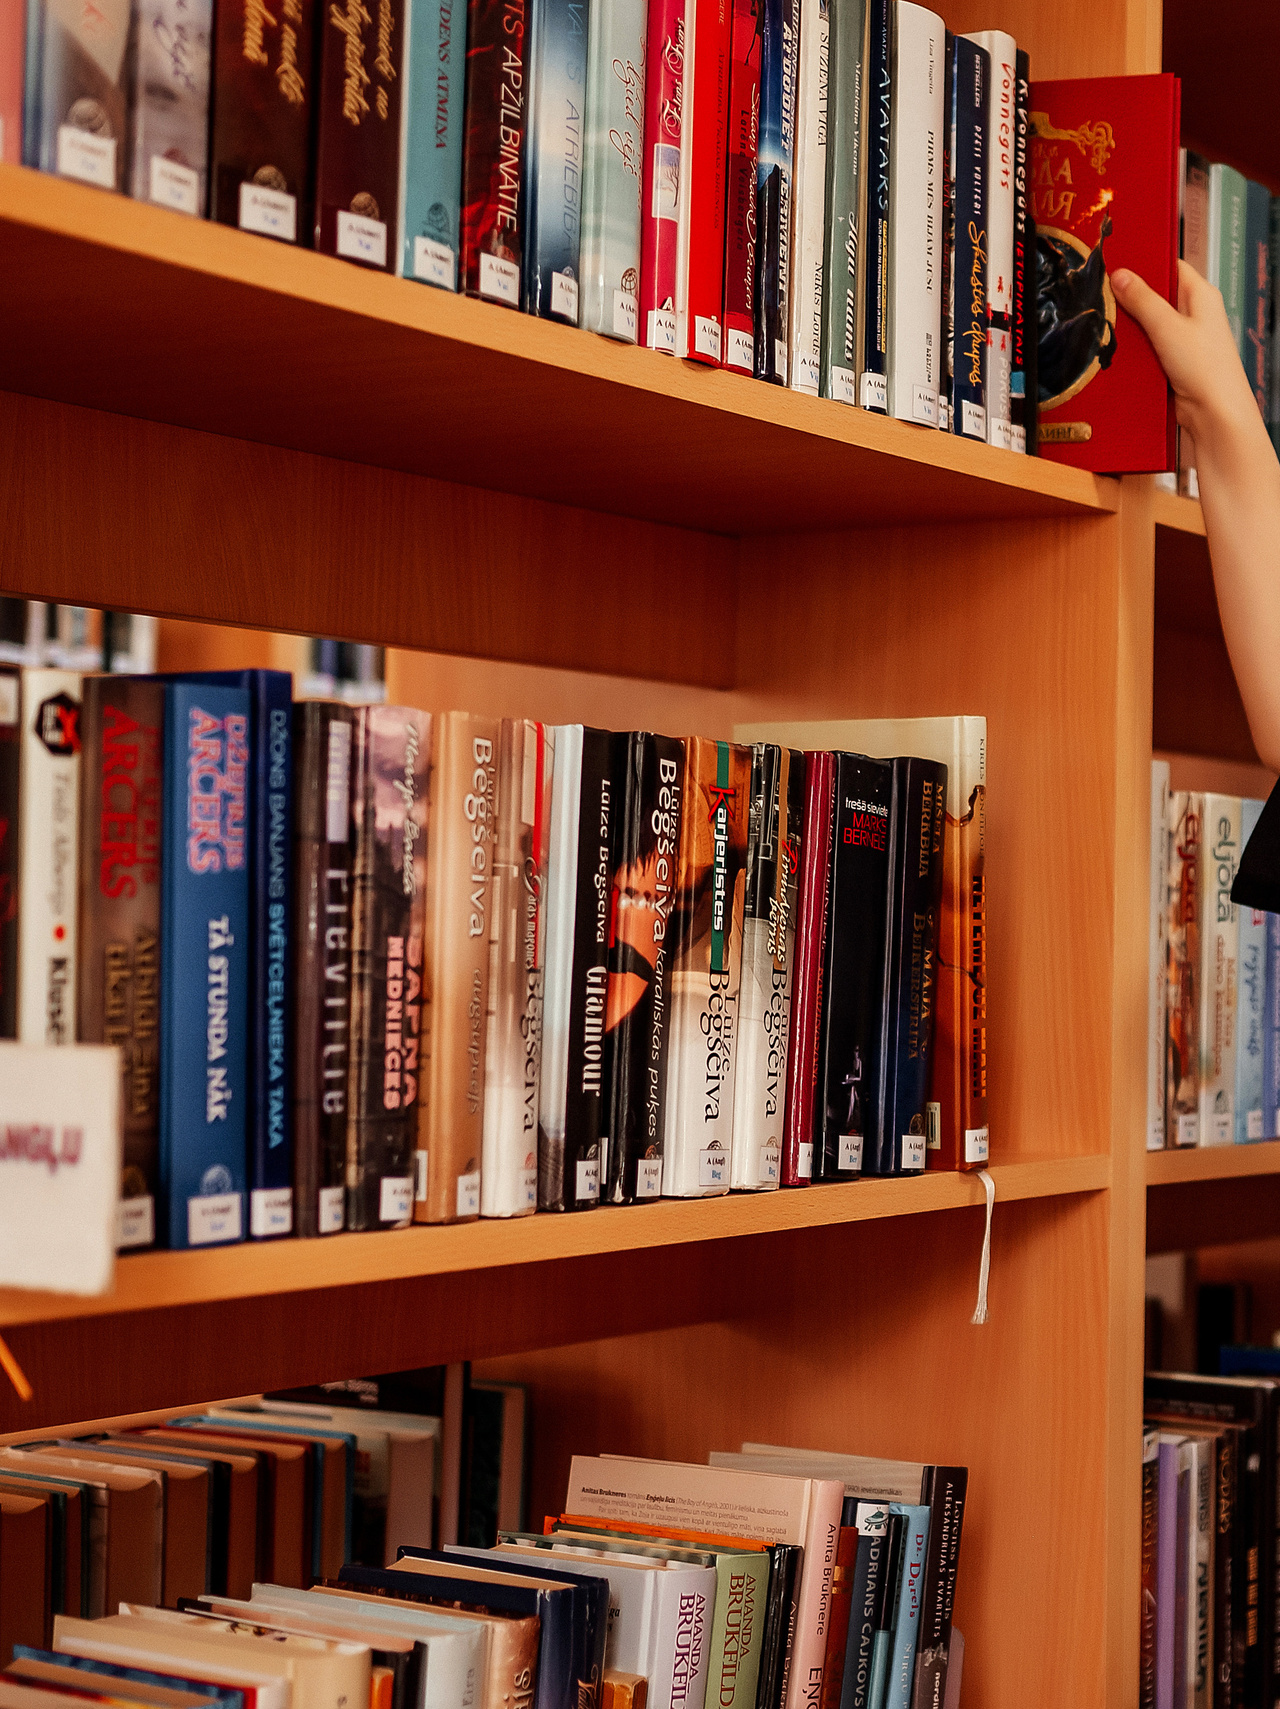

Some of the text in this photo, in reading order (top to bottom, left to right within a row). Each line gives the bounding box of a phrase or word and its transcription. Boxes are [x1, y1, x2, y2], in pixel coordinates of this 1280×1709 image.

[498, 46, 524, 232] APŽILBINĀTIE
[187, 708, 222, 876] ARCERS
[268, 793, 286, 899] BANJANS
[464, 737, 494, 939] Begšeiva
[852, 812, 887, 835] MARKS
[708, 784, 735, 932] Karjeristes
[646, 758, 677, 1136] Begšeiva karaliskās puķes
[207, 955, 231, 1062] STUNDA
[582, 965, 608, 1097] Glamour
[268, 1085, 284, 1149] TAKA
[741, 1573, 757, 1659] AMANDA
[816, 1523, 837, 1636] Anita Bruknere
[862, 1535, 881, 1617] ADRIANS
[908, 1561, 922, 1618] Darels
[933, 1481, 954, 1638] ALEKSANDRIJAS KVARTETS
[670, 1592, 696, 1709] BRUKFĪL
[690, 1593, 706, 1680] AMANDA
[719, 1572, 746, 1709] BRUKFĪLD
